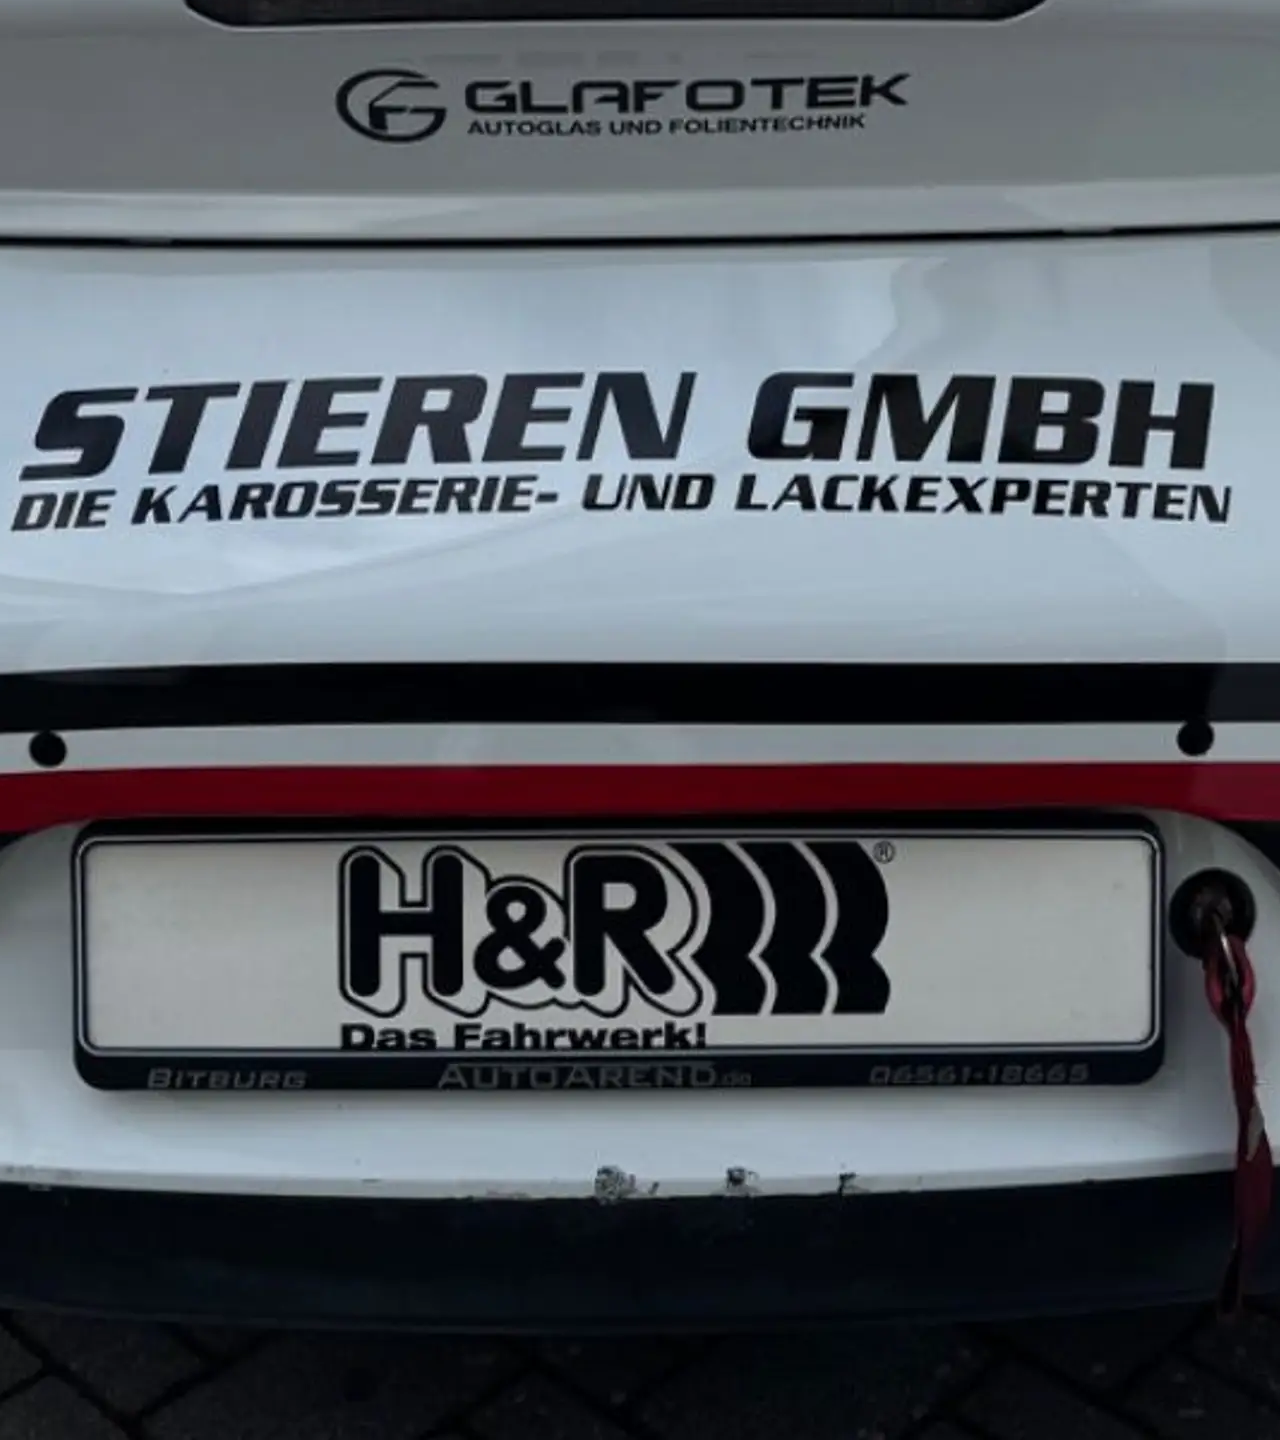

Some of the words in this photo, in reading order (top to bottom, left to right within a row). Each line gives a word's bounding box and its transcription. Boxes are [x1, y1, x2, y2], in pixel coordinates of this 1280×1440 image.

[464, 73, 910, 115] GLAFOTEK
[467, 119, 602, 137] AUTOGLAS
[609, 117, 663, 136] UND
[668, 113, 866, 135] FOLIENTECHNIK
[19, 371, 697, 482] STIEREN
[746, 371, 1216, 470] GMBH
[11, 489, 117, 532] DIE
[130, 474, 560, 526] KAROSSERIE-
[582, 472, 716, 512] UND
[734, 473, 1233, 524] LACKEXPERTEN
[338, 844, 704, 1018] H&R
[340, 1023, 437, 1051] Das
[454, 1021, 707, 1051] Fahrwerk!
[147, 1067, 308, 1088] BITBURG
